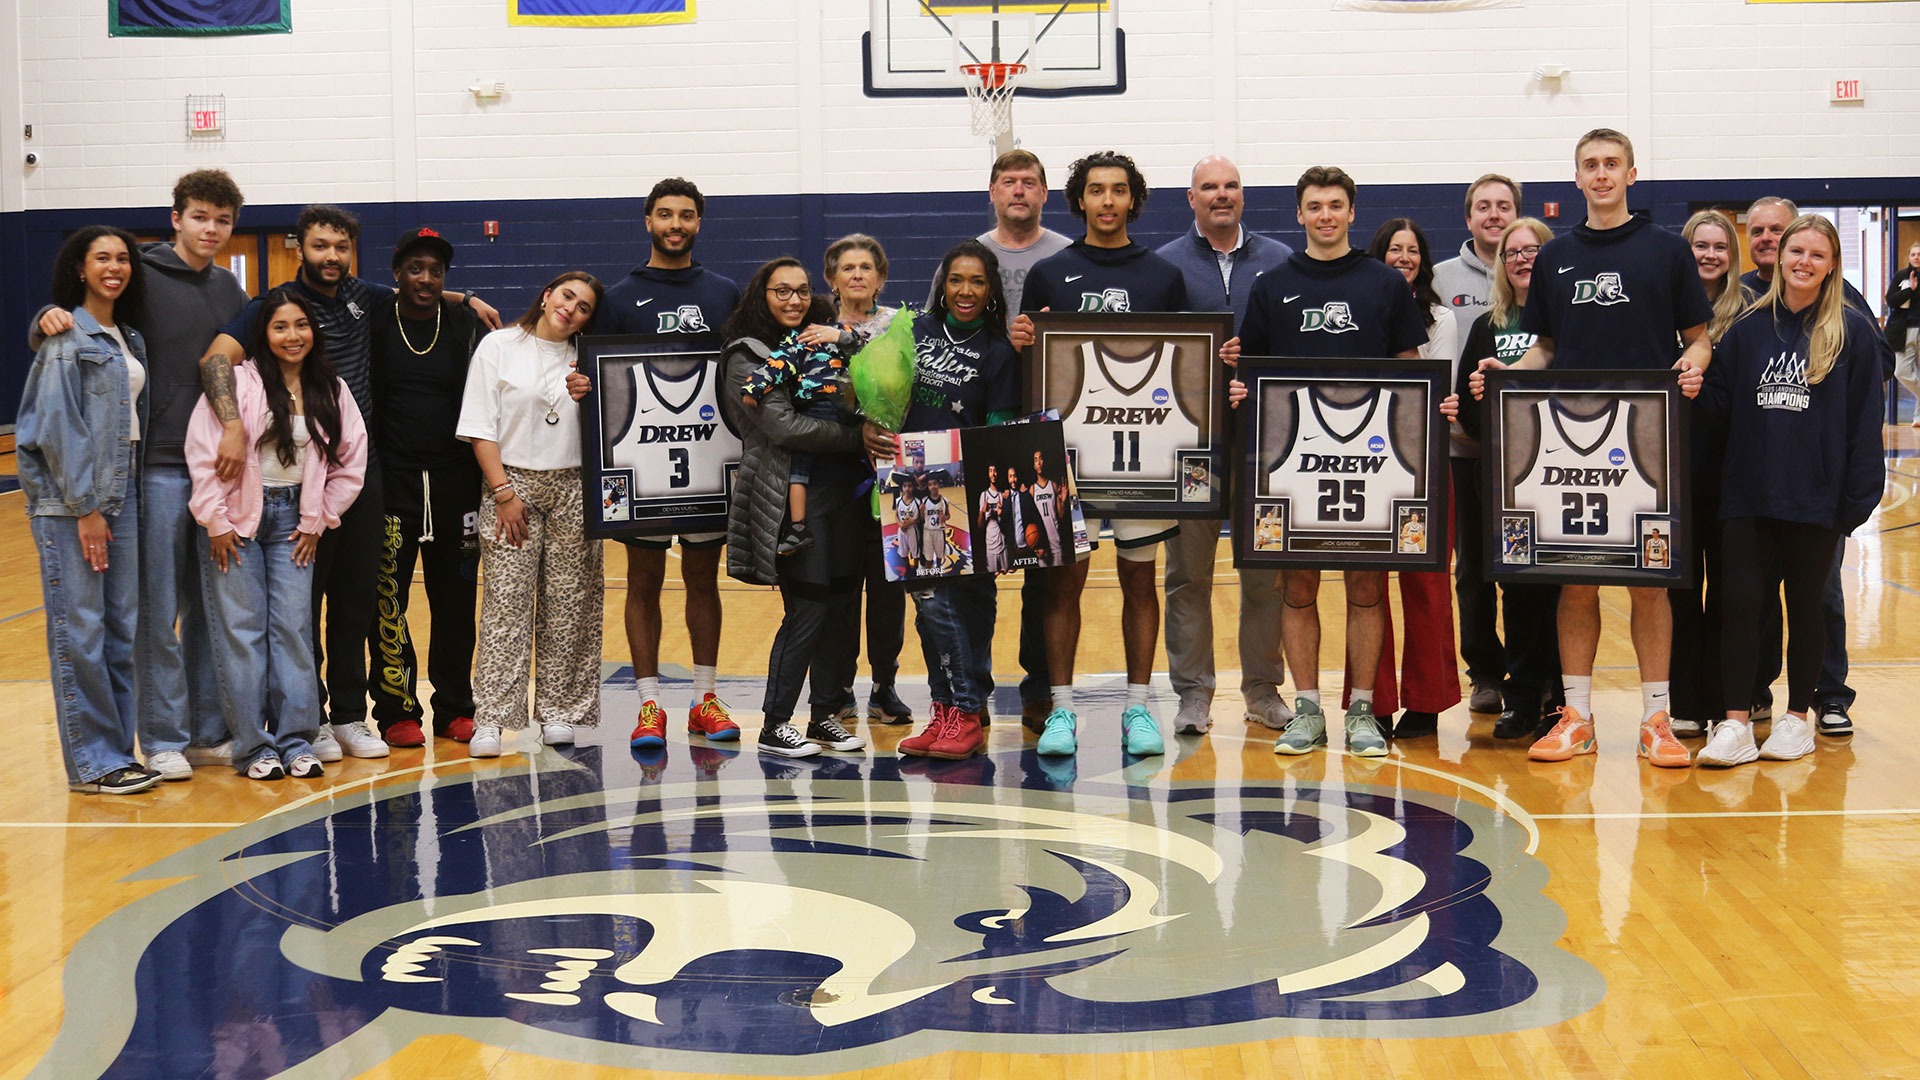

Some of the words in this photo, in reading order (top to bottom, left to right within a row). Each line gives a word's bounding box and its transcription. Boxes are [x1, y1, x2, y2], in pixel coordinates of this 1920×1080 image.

[1836, 80, 1859, 98] EXIT
[195, 111, 217, 129] EXIT
[928, 338, 951, 349] only
[952, 345, 980, 359] raise
[920, 376, 944, 387] mom
[918, 387, 947, 408] REW
[1757, 392, 1810, 408] CHAMPIONS
[1082, 405, 1172, 425] DREW
[637, 423, 718, 444] DREW
[1112, 431, 1141, 471] 11
[669, 448, 690, 488] 3
[1296, 453, 1388, 474] DREW
[1540, 466, 1629, 487] DREW
[1317, 479, 1365, 522] 25
[1562, 492, 1608, 535] 23
[916, 567, 944, 577] BEFORE
[1013, 557, 1038, 566] AFTER
